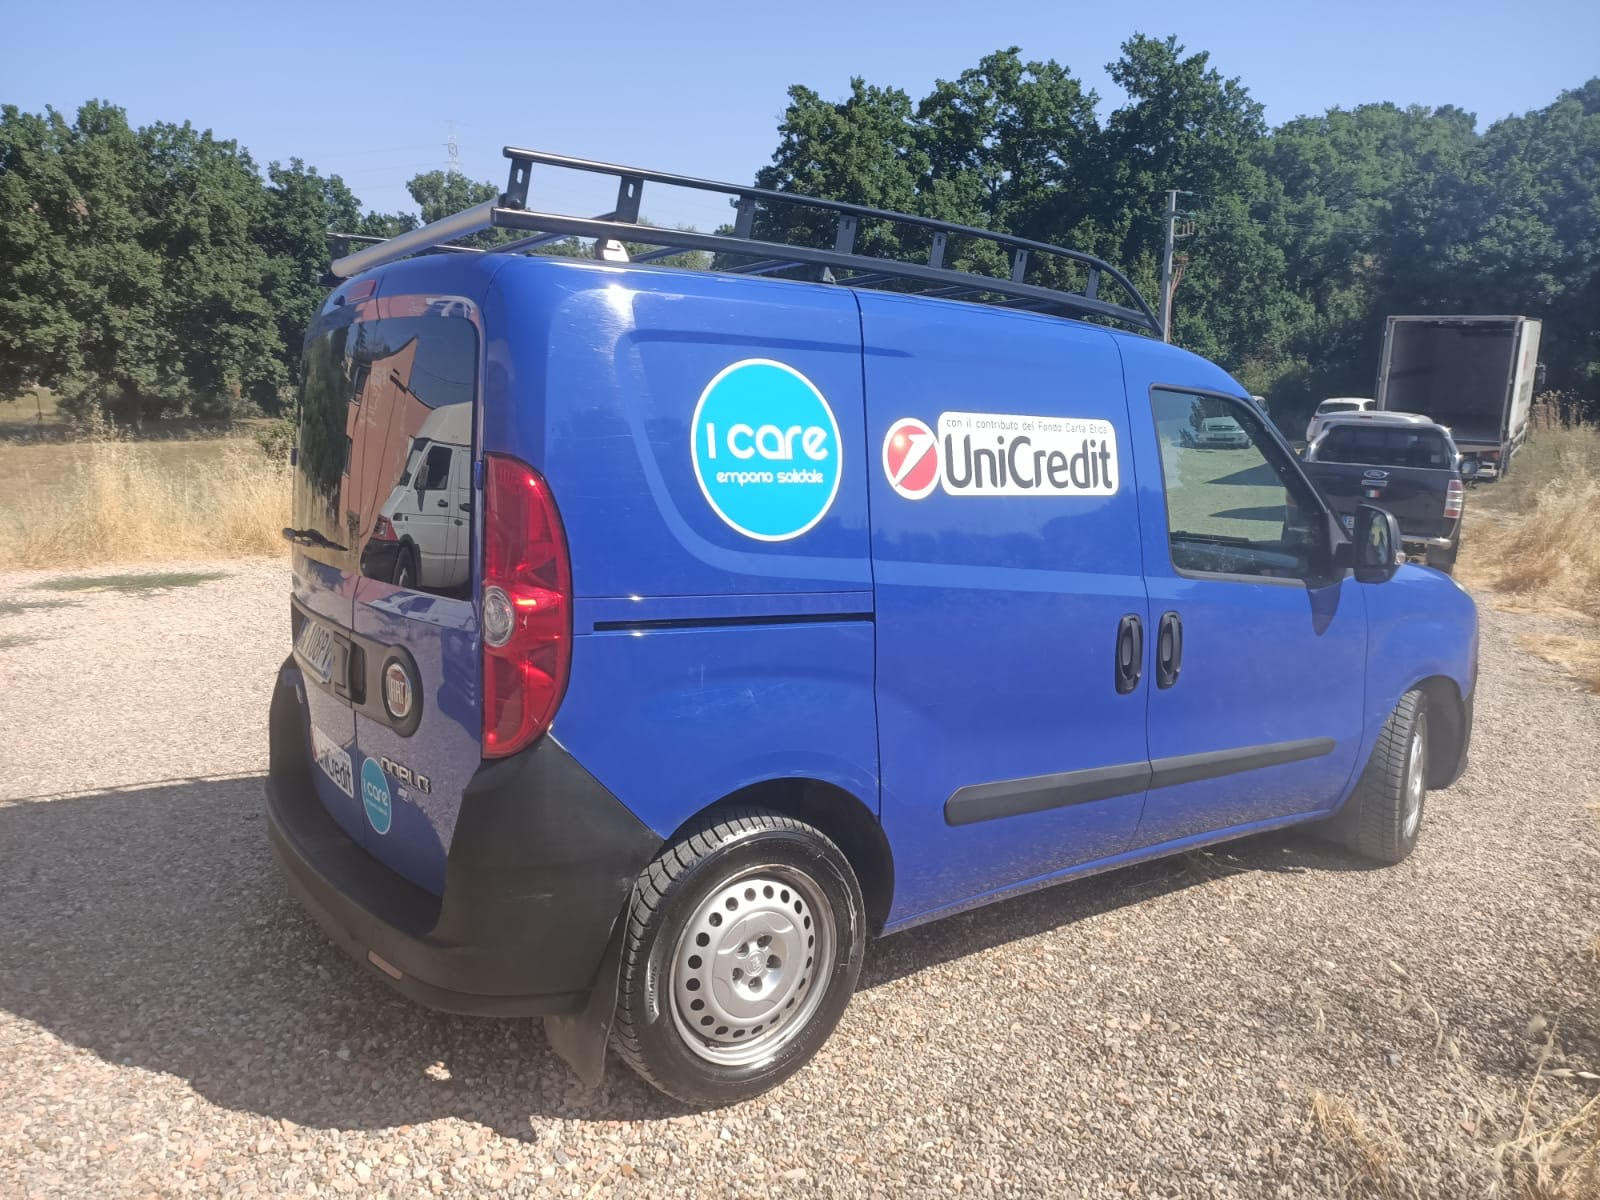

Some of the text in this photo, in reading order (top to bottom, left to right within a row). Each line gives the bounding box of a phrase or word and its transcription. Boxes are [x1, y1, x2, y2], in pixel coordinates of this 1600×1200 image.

[706, 422, 829, 460] I care
[946, 419, 963, 428] con
[976, 418, 1018, 431] contributo
[1022, 421, 1035, 432] del
[944, 433, 1113, 489] UniCredit
